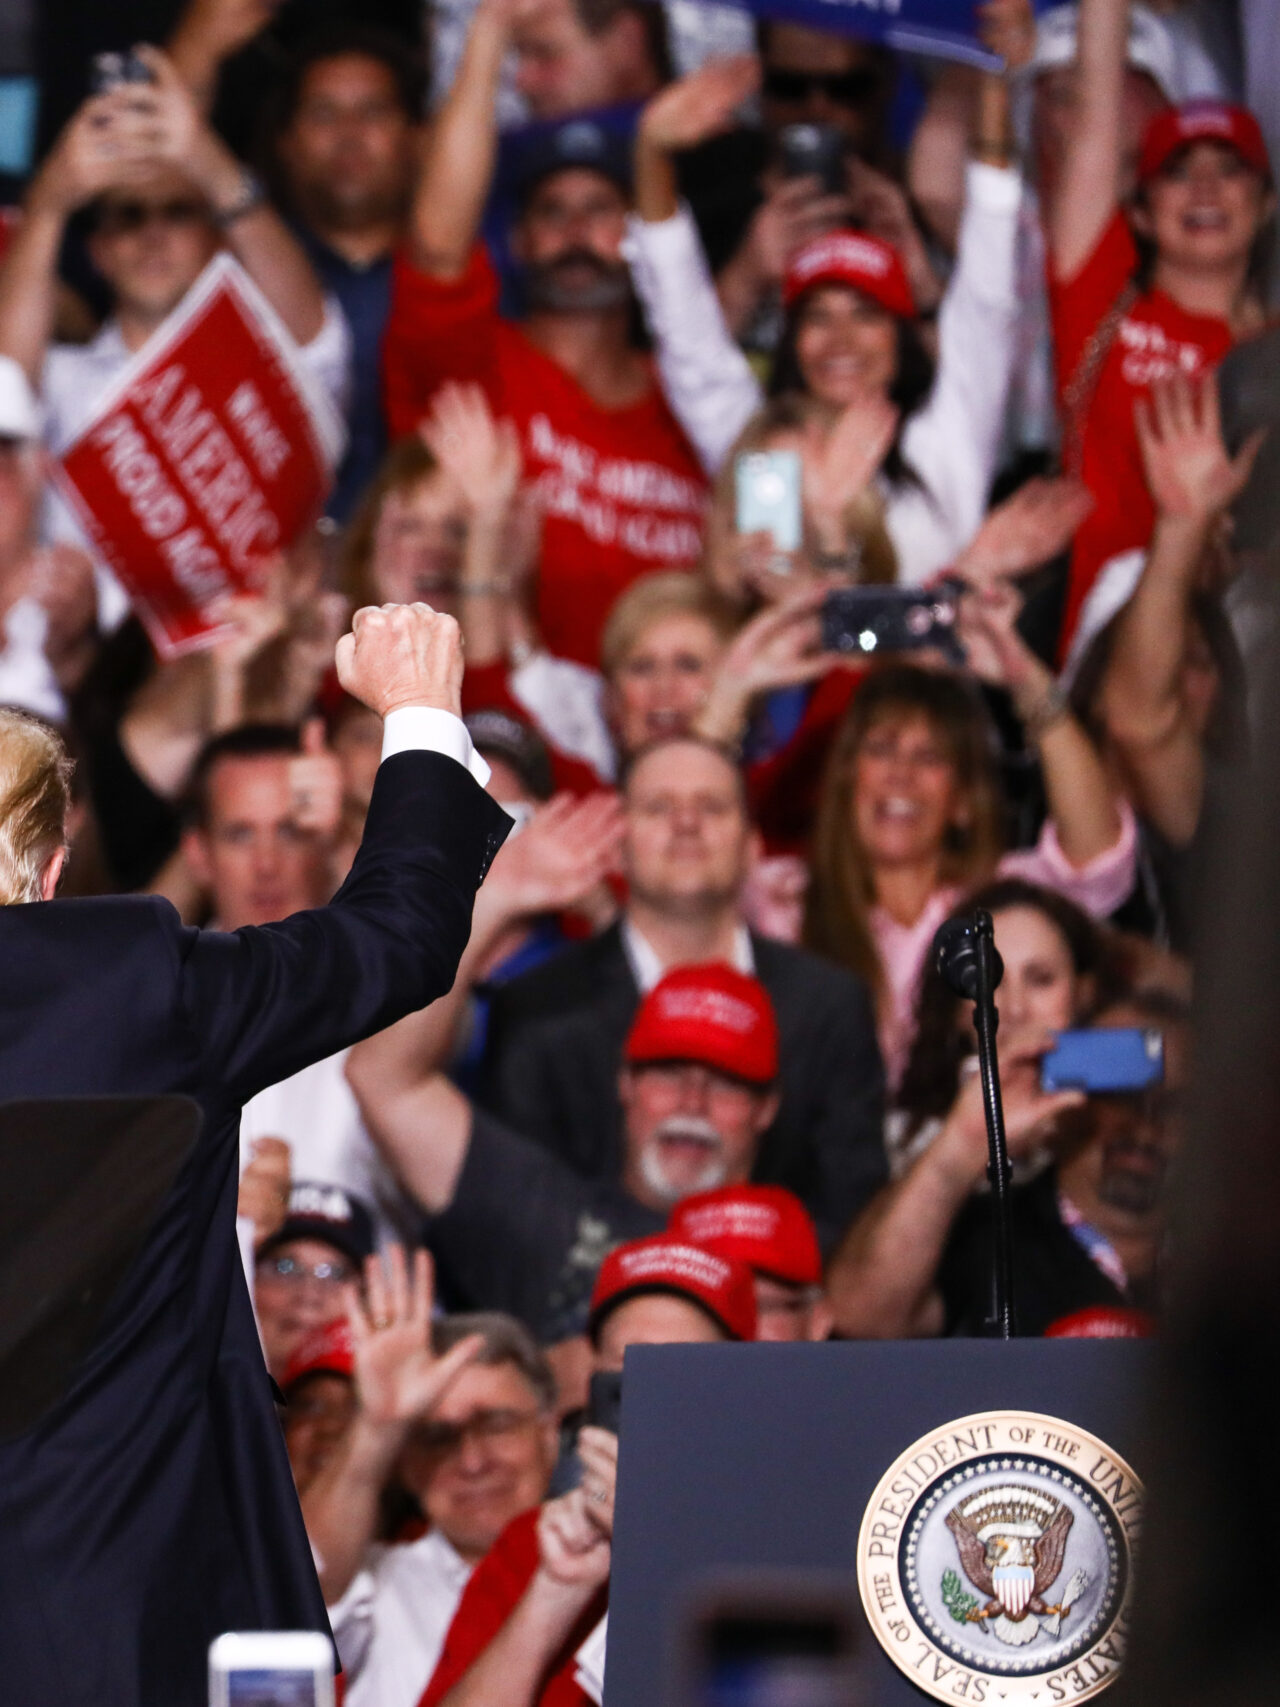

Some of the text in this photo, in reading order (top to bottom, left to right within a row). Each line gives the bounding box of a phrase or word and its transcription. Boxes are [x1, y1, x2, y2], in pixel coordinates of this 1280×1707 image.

[1008, 1425, 1037, 1444] OF
[1042, 1430, 1081, 1461] THE
[868, 1424, 998, 1560] PRESIDENT
[1089, 1455, 1145, 1524] UNI
[872, 1571, 896, 1614] THE
[887, 1617, 911, 1643] OF
[912, 1640, 991, 1703] SEAL
